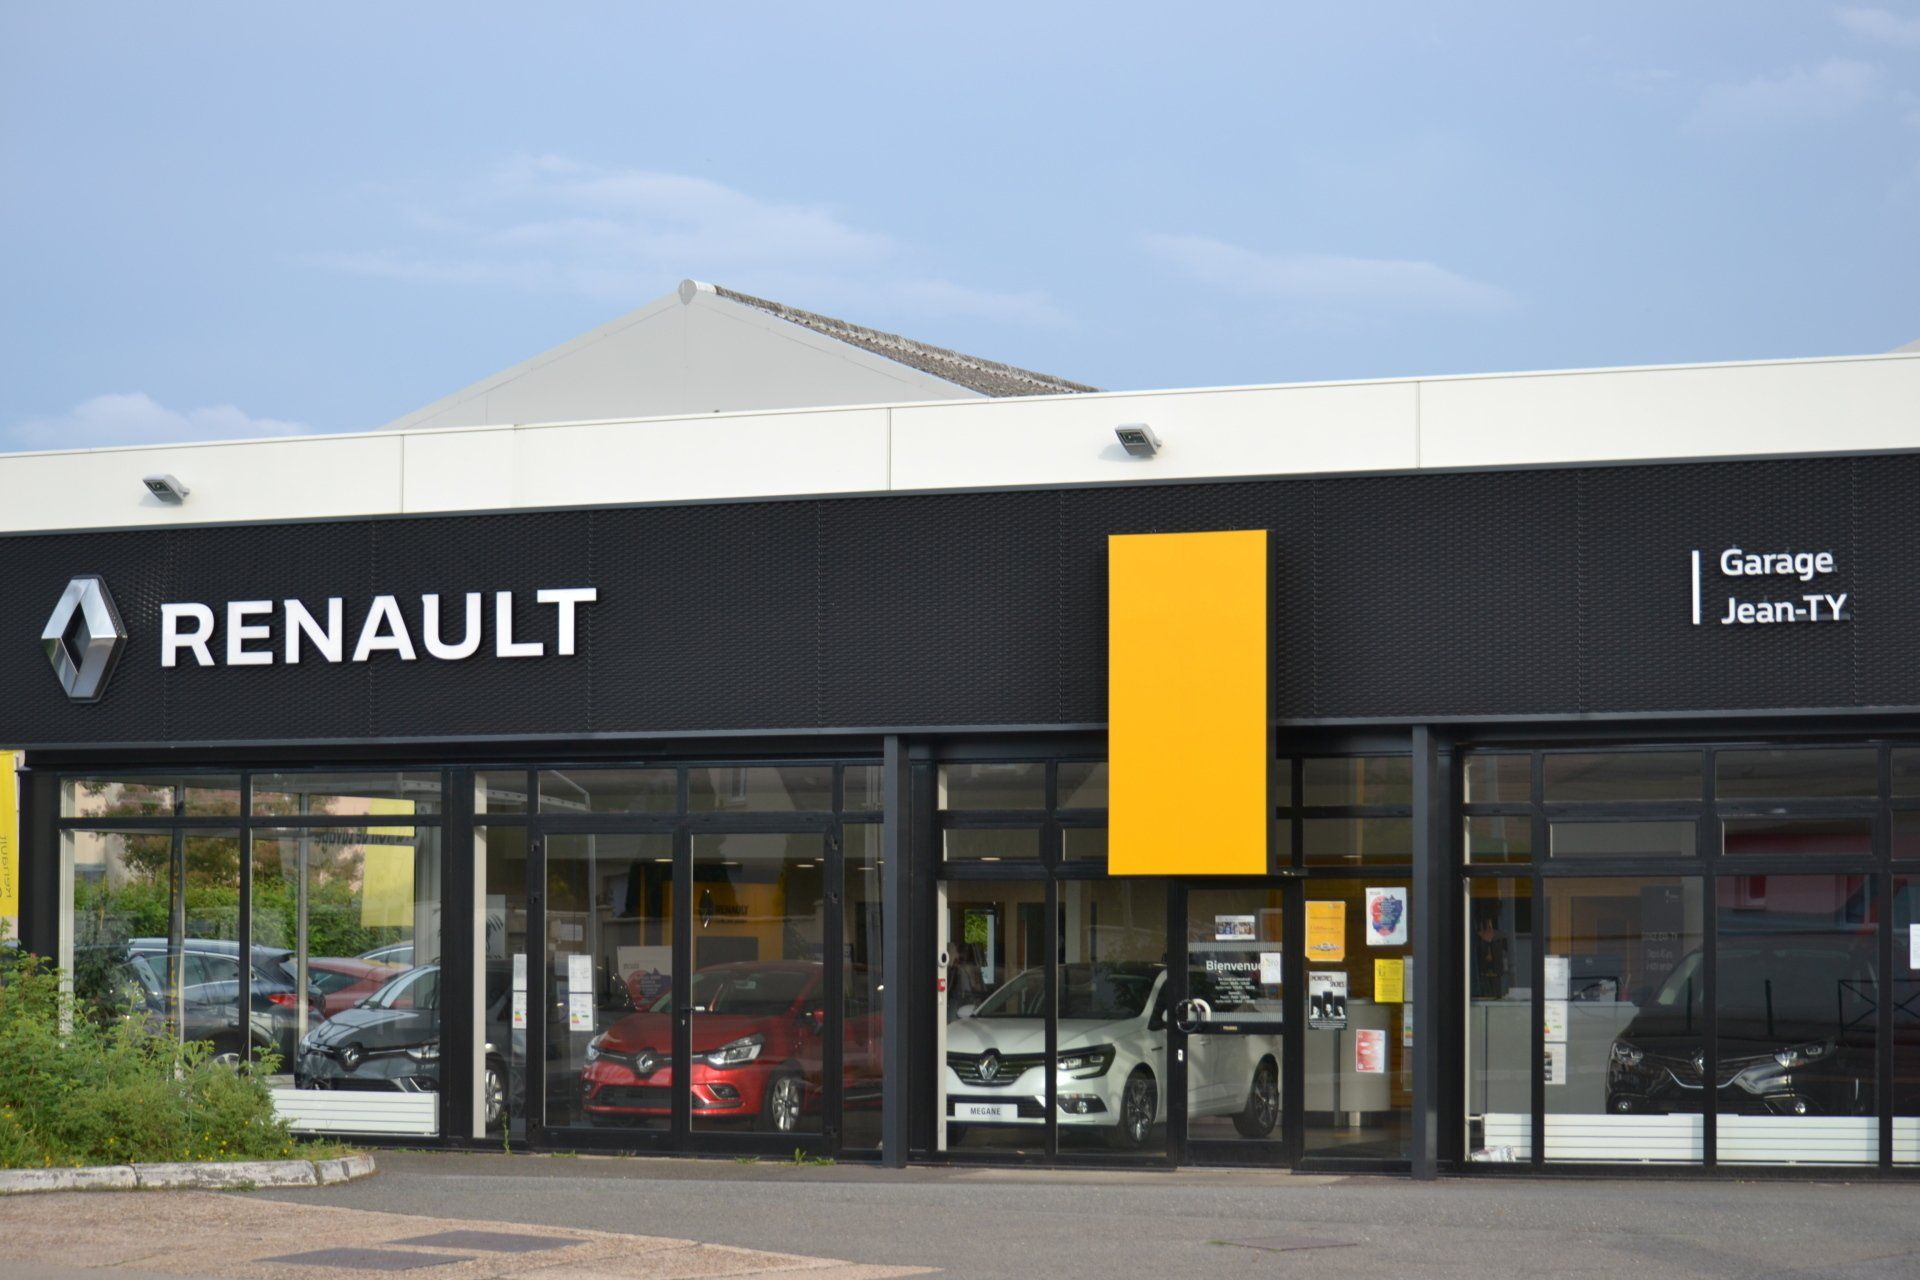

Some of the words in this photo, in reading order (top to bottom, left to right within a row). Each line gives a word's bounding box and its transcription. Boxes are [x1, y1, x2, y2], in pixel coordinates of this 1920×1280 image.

[1720, 548, 1833, 581] Garage
[1720, 594, 1847, 625] Jean-TY
[160, 587, 597, 667] RENAULT
[970, 1107, 1001, 1115] MEGANE
